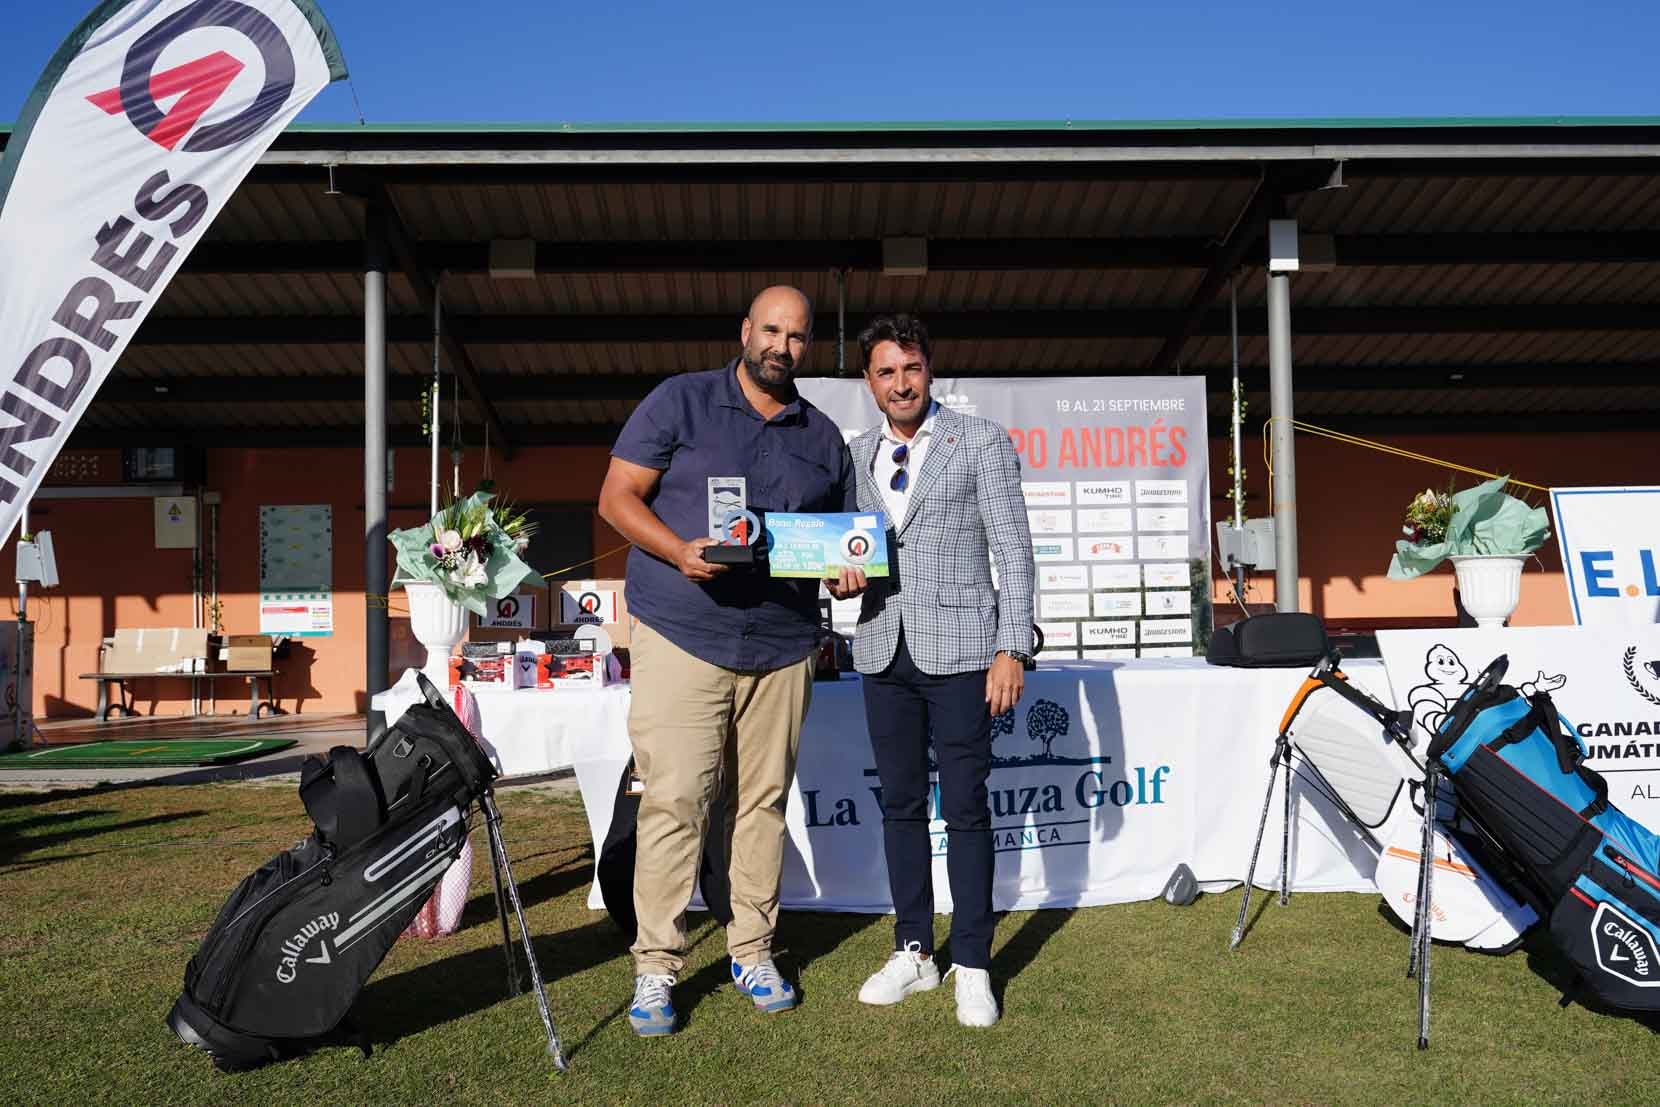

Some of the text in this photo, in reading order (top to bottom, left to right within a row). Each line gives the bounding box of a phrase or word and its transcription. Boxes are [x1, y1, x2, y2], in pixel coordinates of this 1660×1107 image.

[0, 168, 208, 506] NDRÉS
[1056, 399, 1185, 412] 19 AL 21 SEPTIEMBRE
[1057, 418, 1188, 469] ANDRÉS
[803, 789, 861, 828] La
[1075, 766, 1171, 809] Golf
[276, 910, 341, 984] Callaway
[1603, 921, 1649, 976] Callaway
